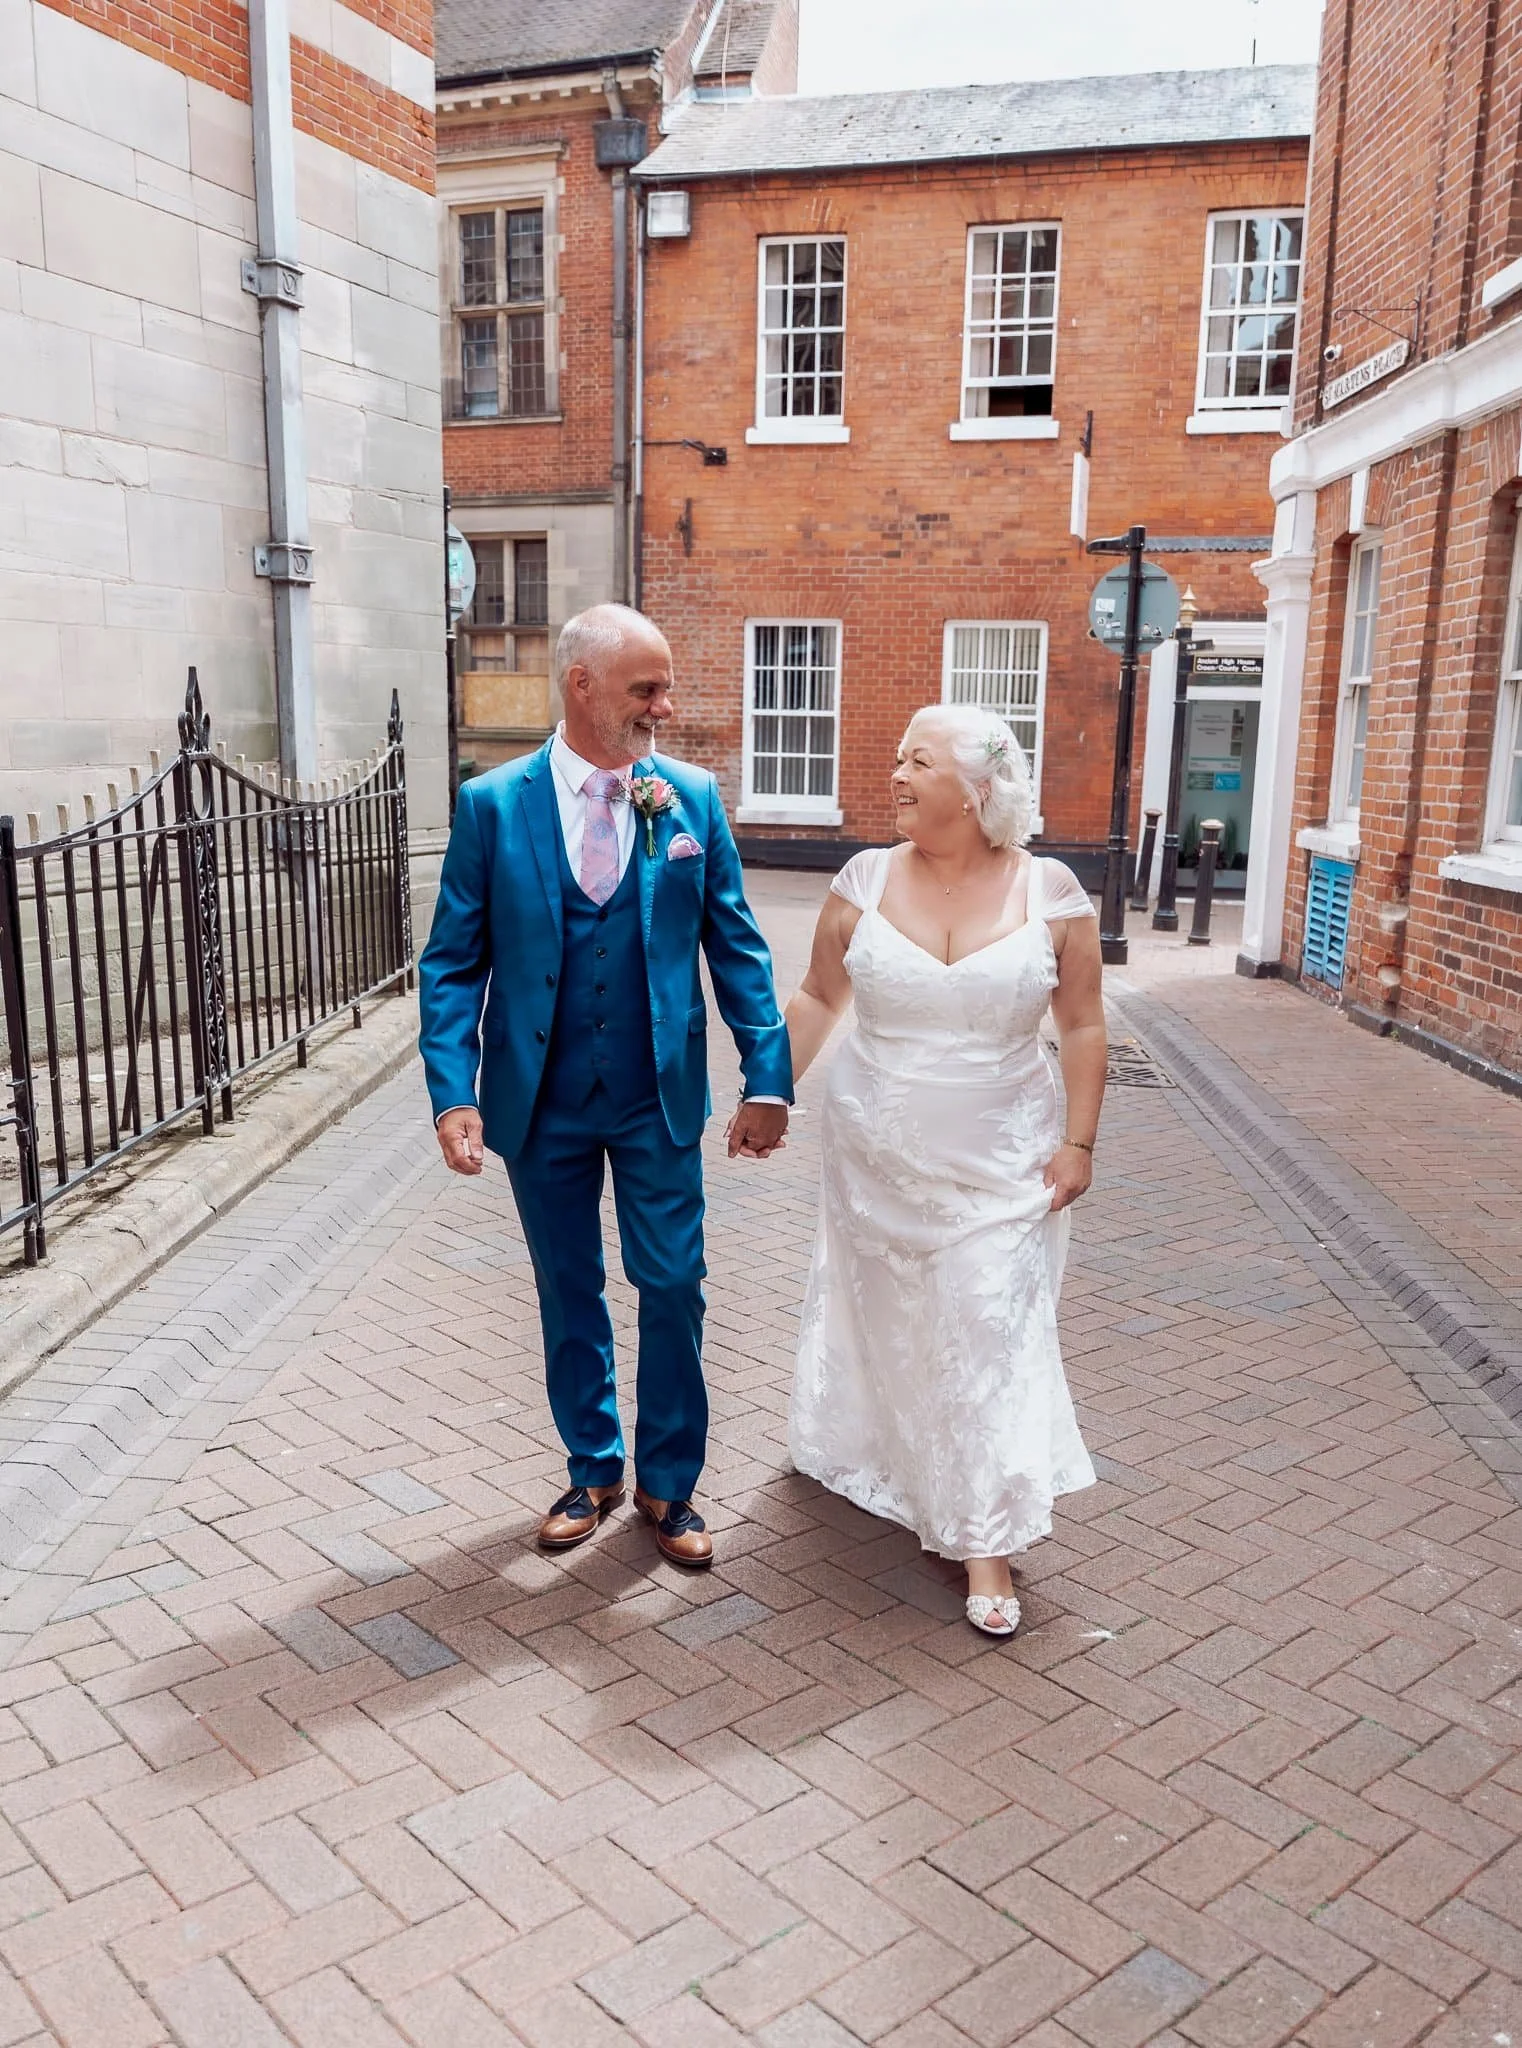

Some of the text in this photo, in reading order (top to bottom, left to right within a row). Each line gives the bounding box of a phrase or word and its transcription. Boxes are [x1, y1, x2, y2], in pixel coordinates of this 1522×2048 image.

[1373, 344, 1403, 377] PLACE
[1197, 657, 1219, 665] Ancient
[1221, 658, 1236, 666] High
